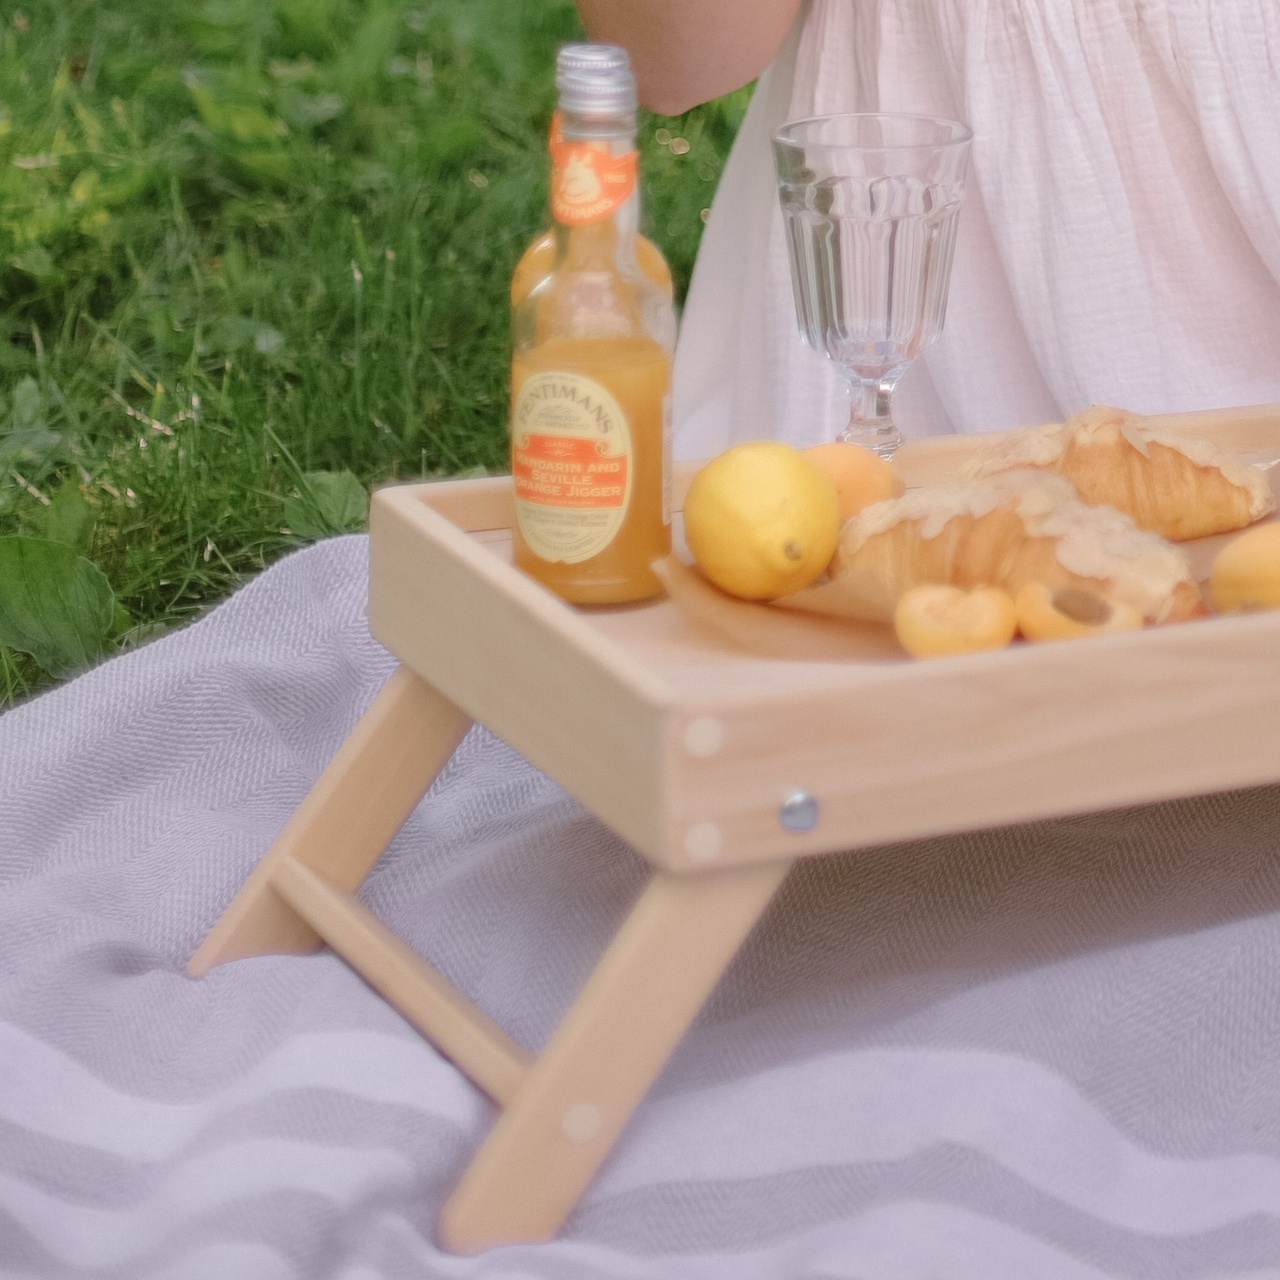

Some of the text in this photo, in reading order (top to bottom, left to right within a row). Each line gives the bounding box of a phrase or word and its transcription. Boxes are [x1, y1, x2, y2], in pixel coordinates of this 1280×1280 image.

[518, 383, 614, 434] FENTIMANS
[516, 451, 620, 474] MANDARIN AND
[516, 475, 621, 498] ORANGE JIGGER
[531, 469, 593, 485] SEVILLE
